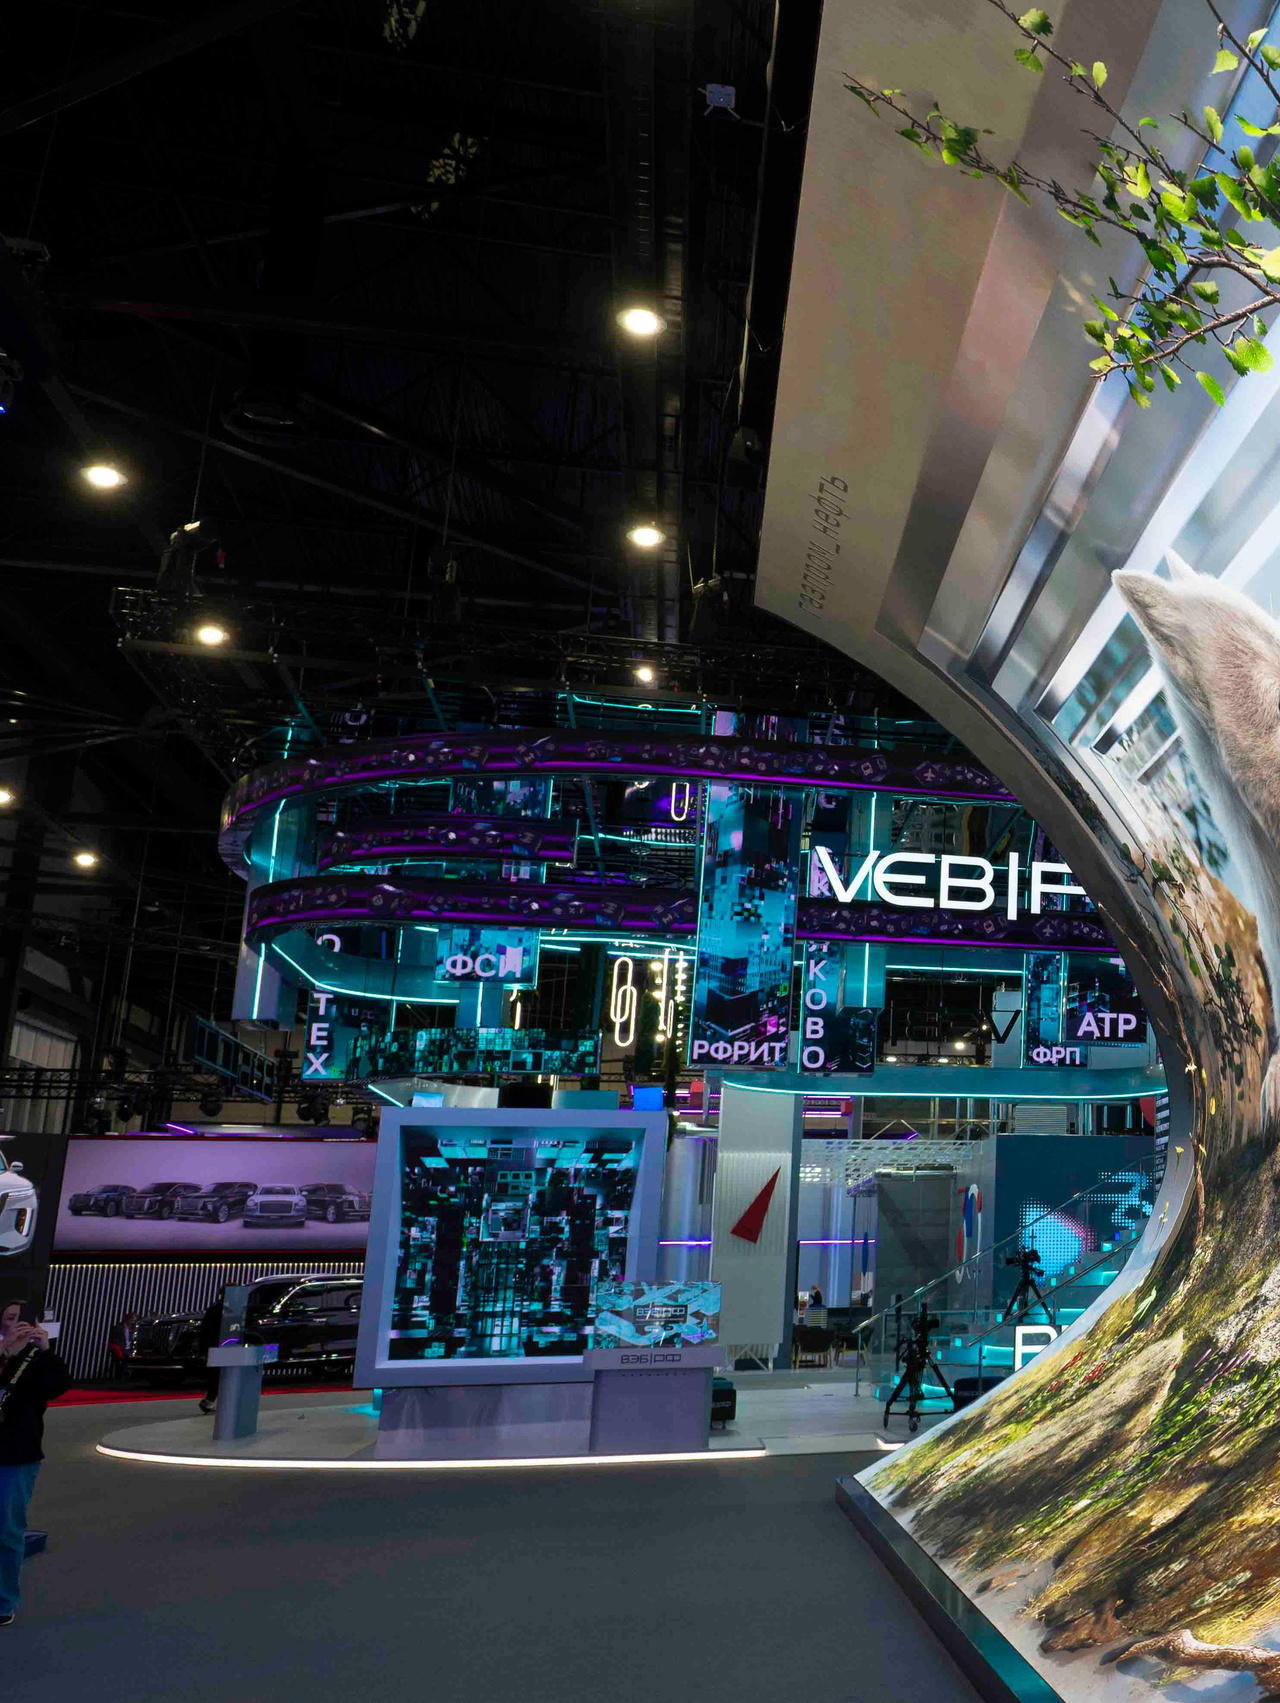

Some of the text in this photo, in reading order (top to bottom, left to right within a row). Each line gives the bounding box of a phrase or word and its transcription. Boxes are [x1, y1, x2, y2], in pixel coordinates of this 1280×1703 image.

[1077, 1012, 1137, 1038] АТР
[692, 1040, 785, 1062] РФРИТ
[1032, 1045, 1080, 1066] ФРП
